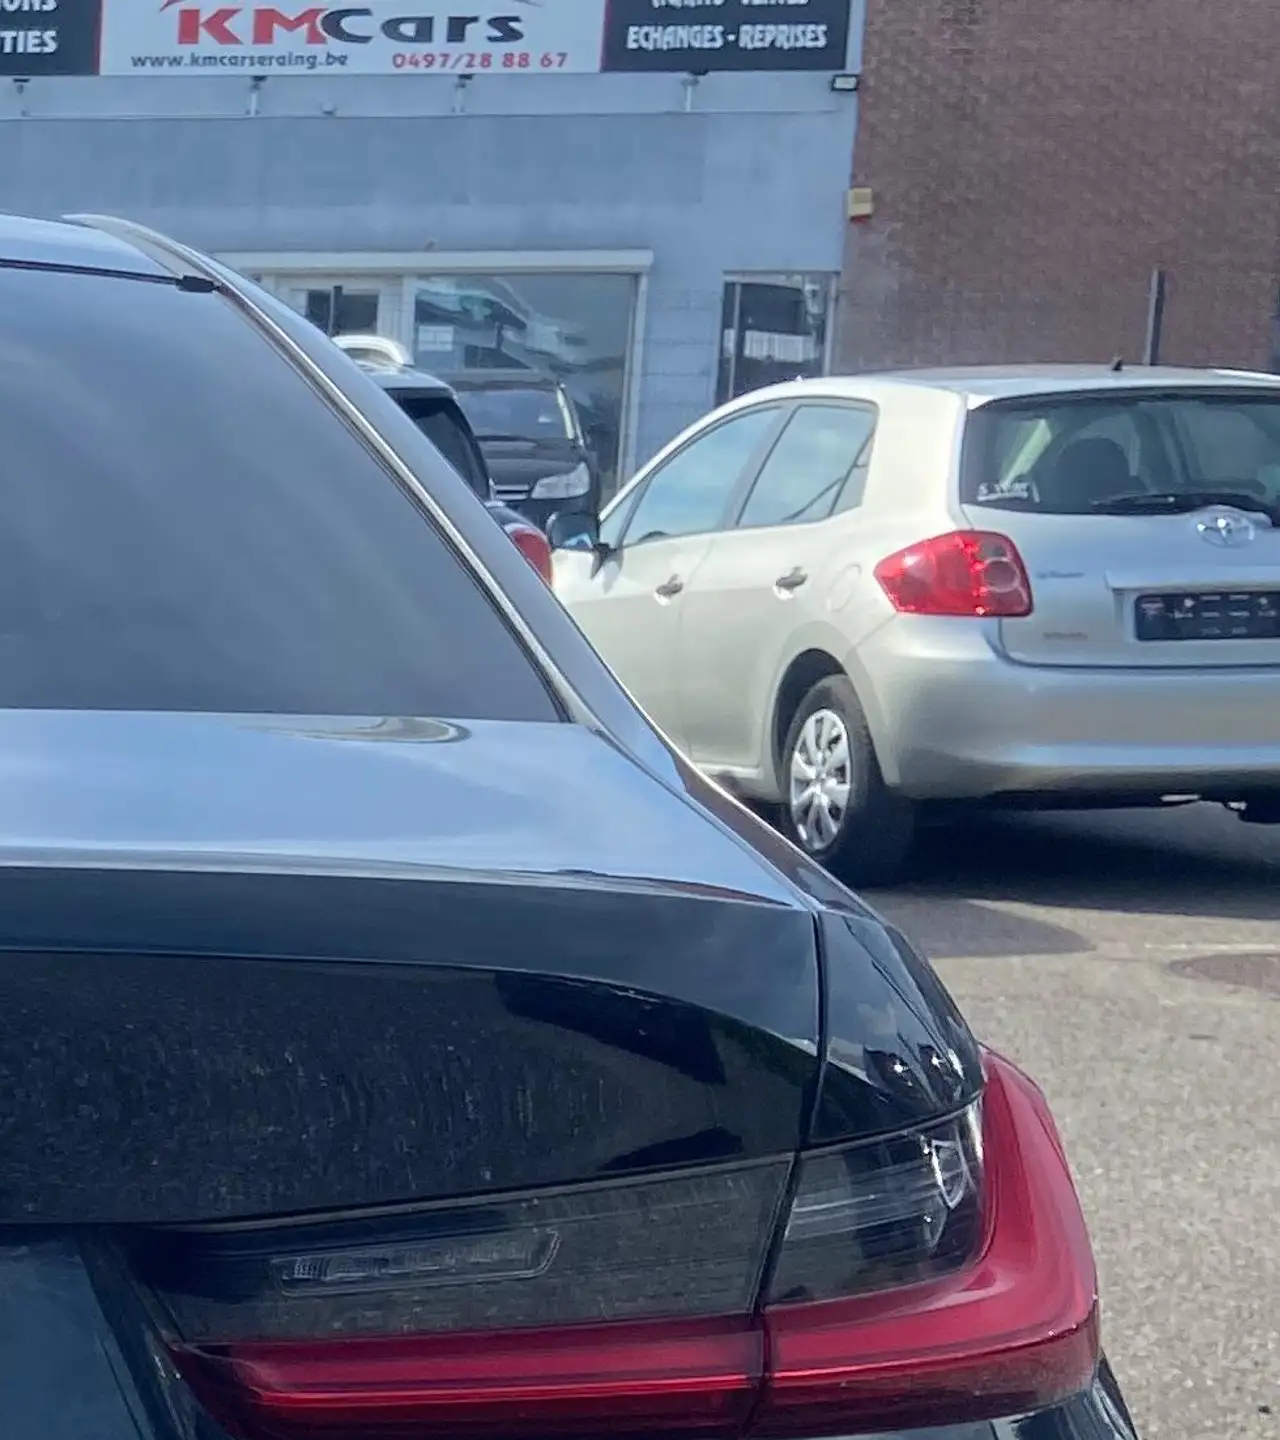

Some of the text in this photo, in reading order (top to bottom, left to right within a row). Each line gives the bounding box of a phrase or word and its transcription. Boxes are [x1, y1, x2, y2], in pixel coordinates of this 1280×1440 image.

[178, 8, 524, 44] KMCars
[130, 52, 348, 69] www.kmcarseraing.be
[392, 52, 568, 68] 0497/28 88 67
